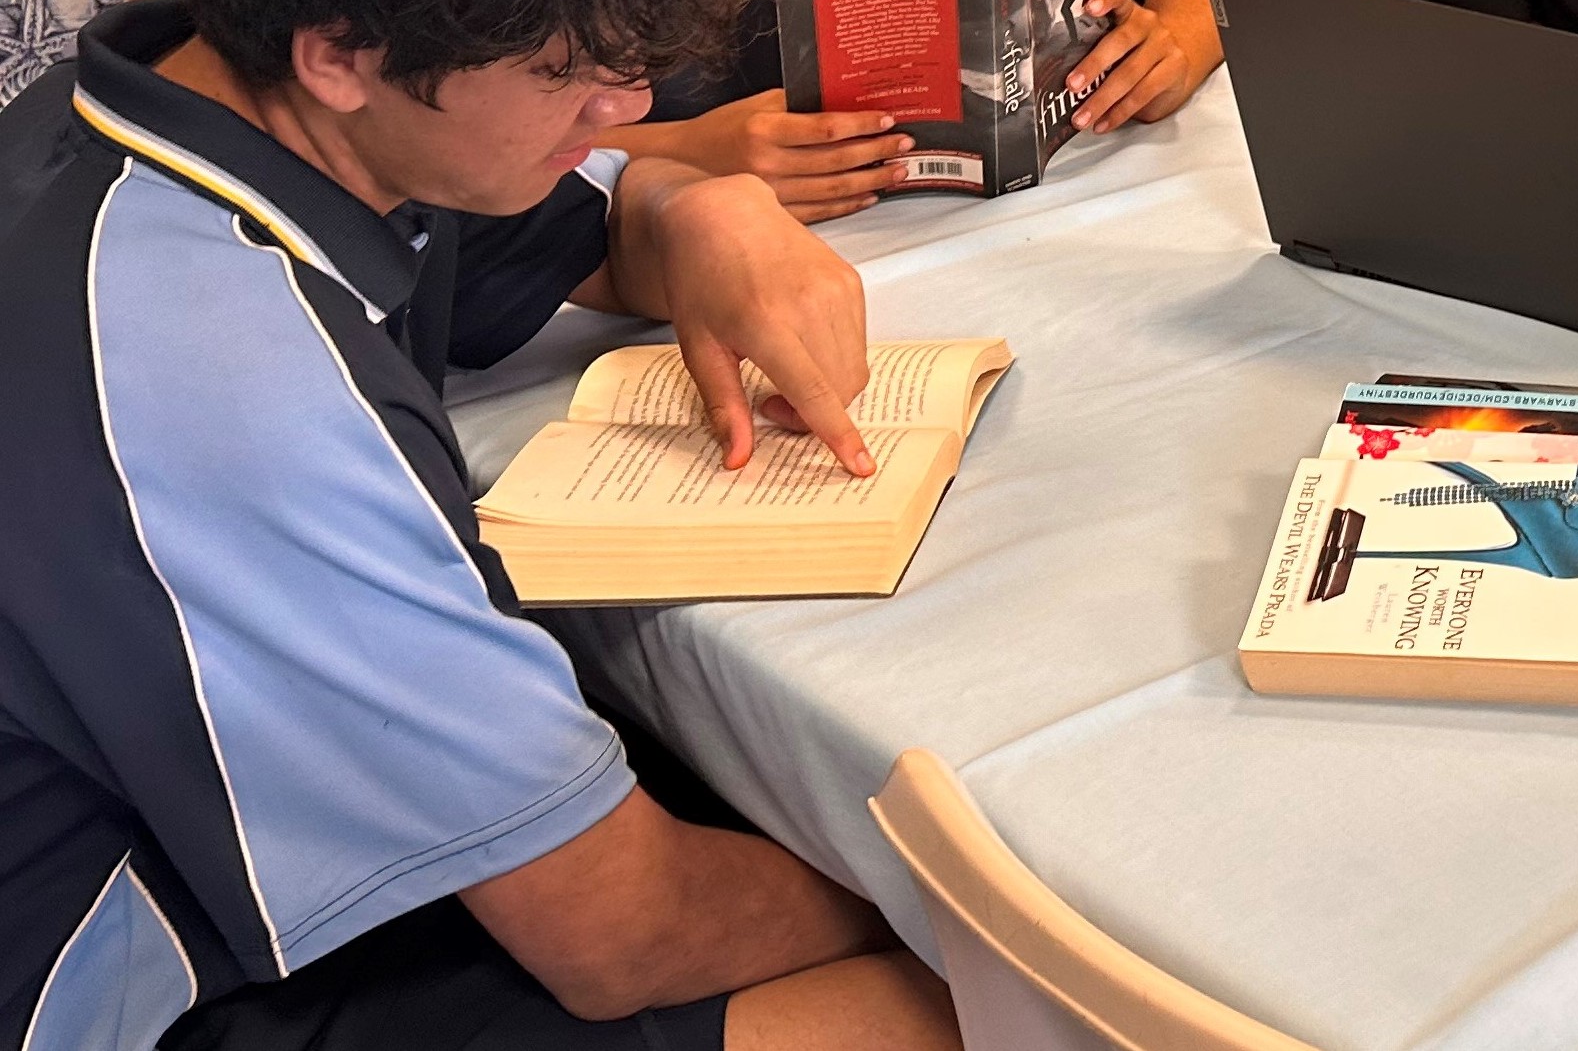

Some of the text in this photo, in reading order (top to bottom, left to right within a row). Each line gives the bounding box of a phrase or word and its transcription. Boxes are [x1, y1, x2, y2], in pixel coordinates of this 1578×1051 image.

[1001, 46, 1025, 114] finale
[1256, 474, 1322, 638] THE DEVIL WEARS PRADA
[1394, 565, 1440, 650] KNOWING
[1428, 588, 1450, 626] WORTH
[1442, 568, 1484, 651] EVERYONE
